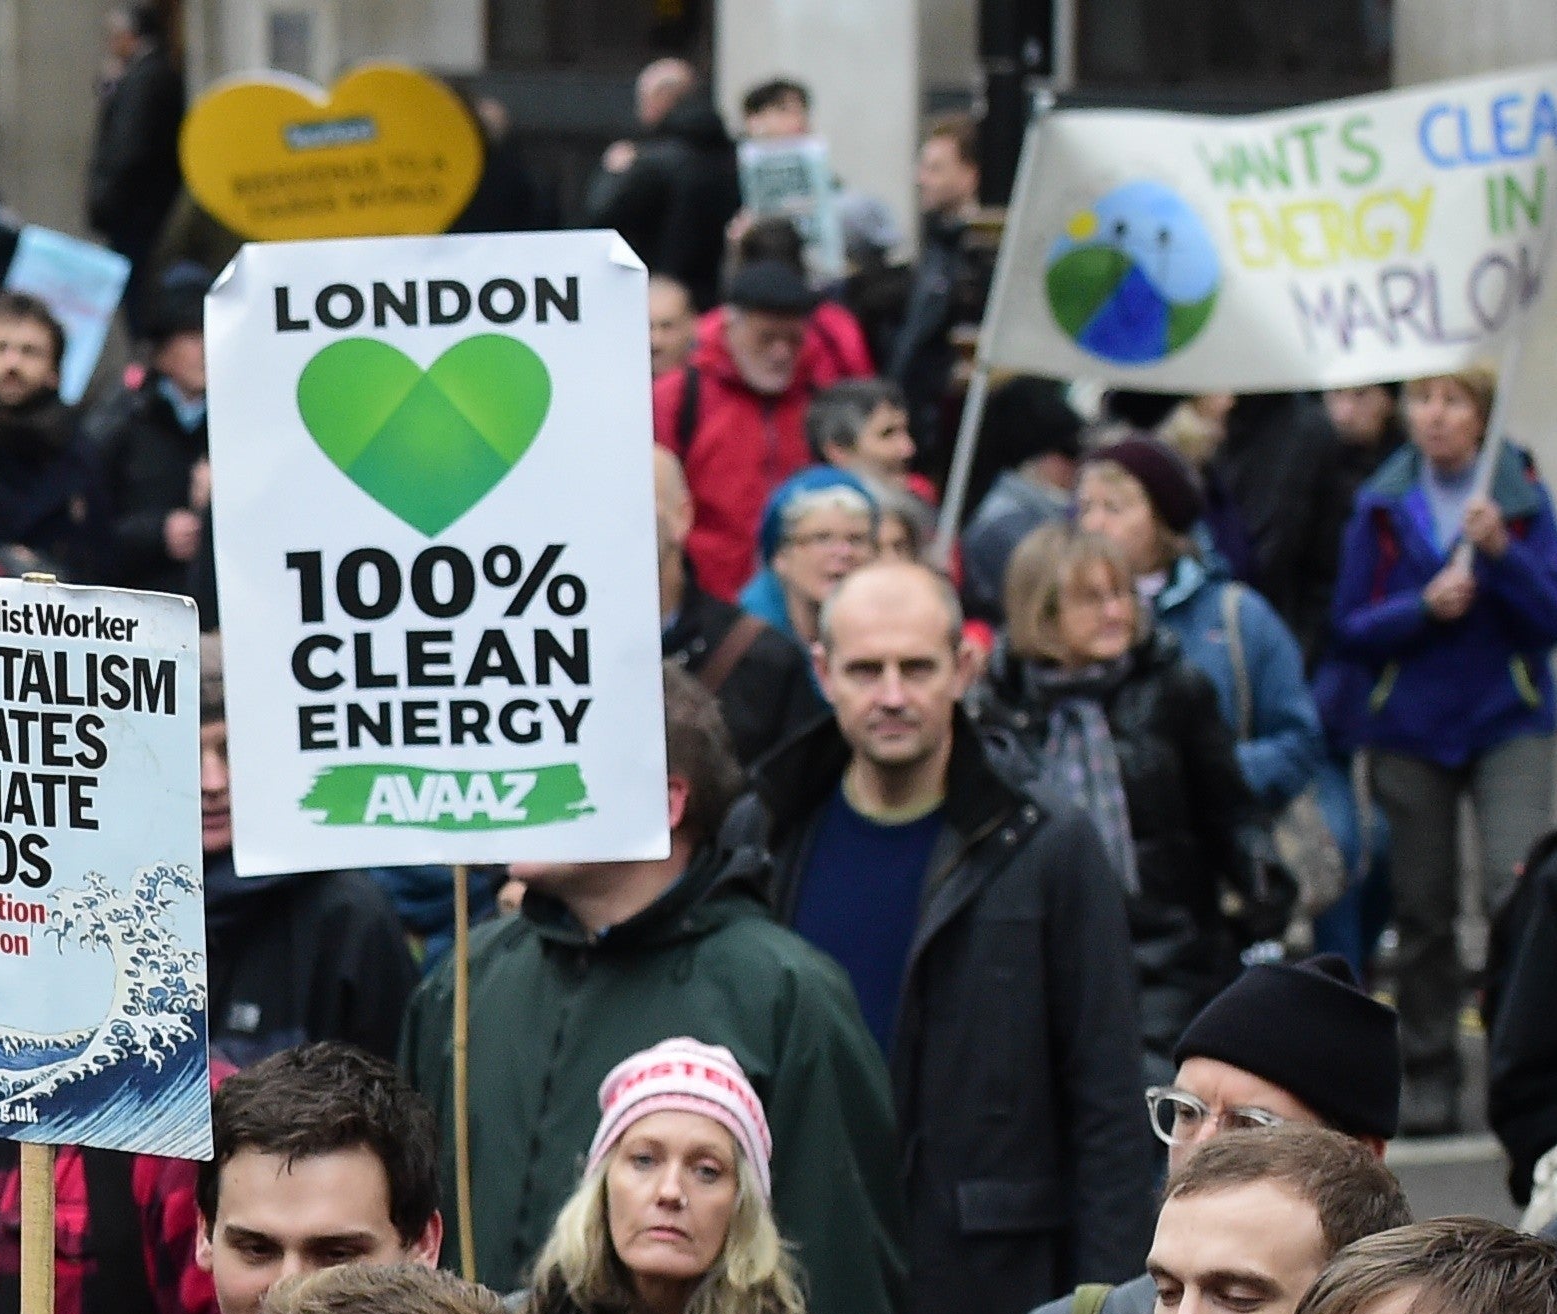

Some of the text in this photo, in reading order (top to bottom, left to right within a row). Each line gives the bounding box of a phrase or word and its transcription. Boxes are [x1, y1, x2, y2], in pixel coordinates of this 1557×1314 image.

[1194, 114, 1382, 190] WANTS
[1228, 164, 1547, 269] ENERGY IN
[273, 276, 581, 332] LONDON
[285, 544, 588, 625] 100%
[290, 628, 593, 692] CLEAN
[297, 698, 594, 751] ENERGY
[363, 772, 538, 824] AVAAZ
